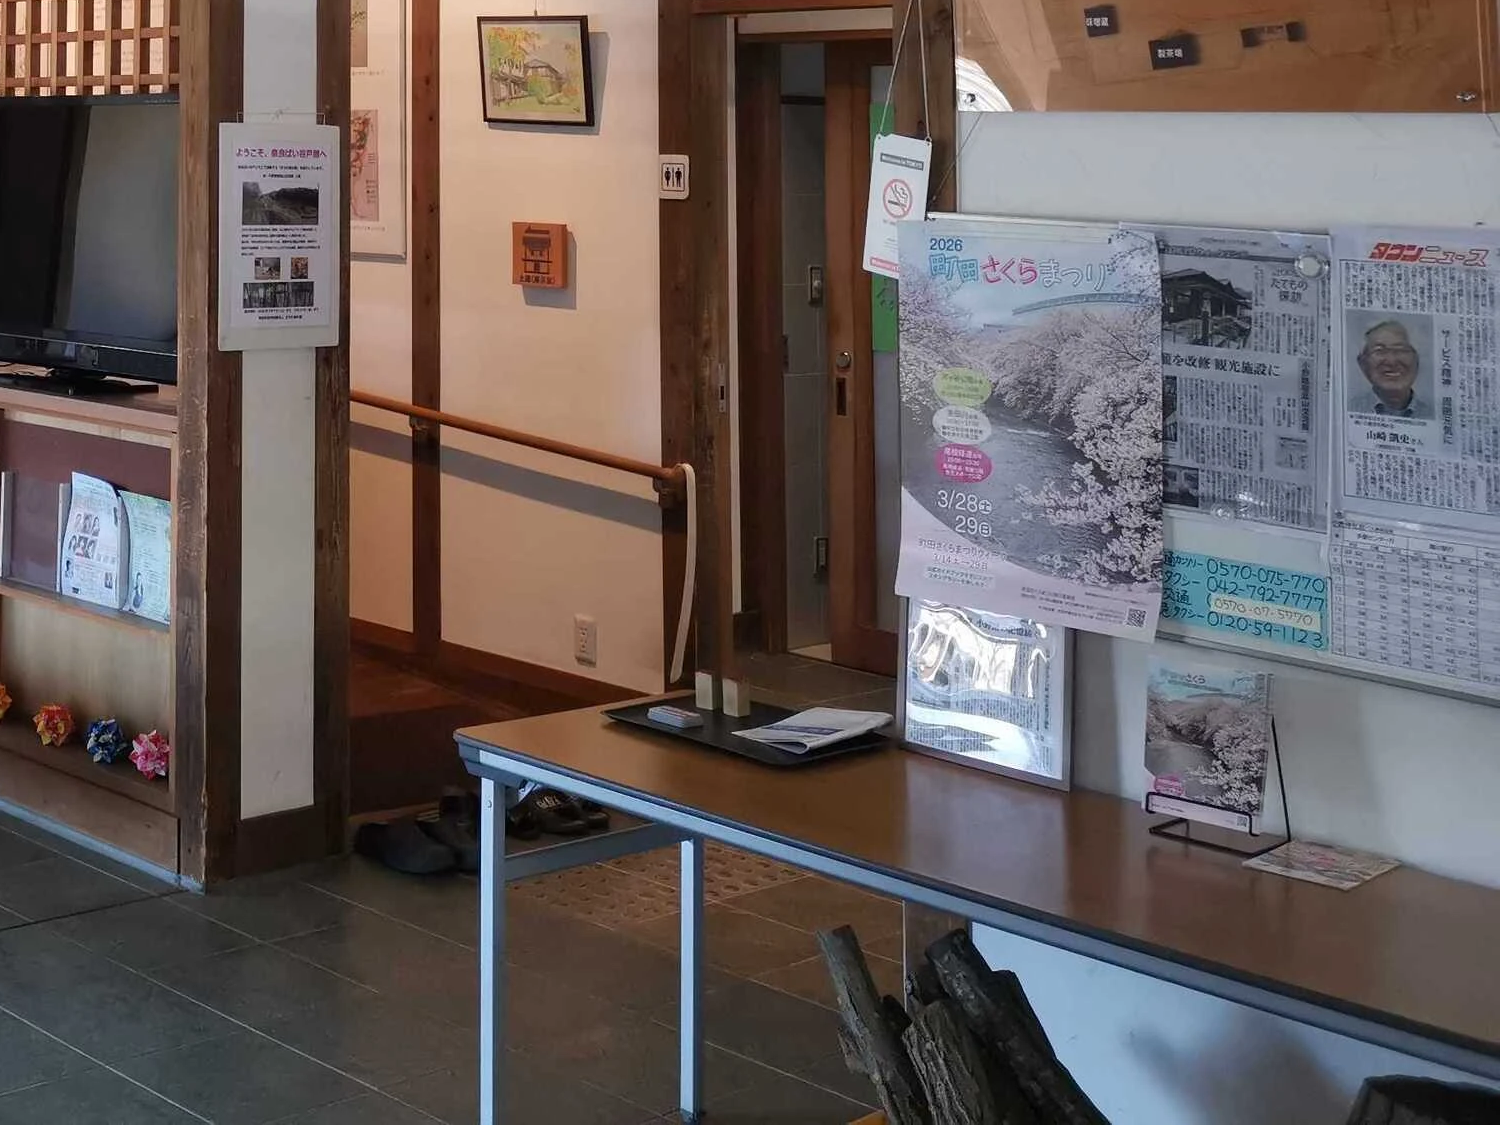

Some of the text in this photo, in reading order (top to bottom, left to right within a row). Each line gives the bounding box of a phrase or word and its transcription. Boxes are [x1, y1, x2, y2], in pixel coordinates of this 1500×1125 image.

[930, 238, 963, 252] 2026
[1369, 242, 1490, 268] タウンニュース
[929, 253, 1108, 292] 町田さくらまつり
[1270, 278, 1308, 291] たてもの
[1215, 357, 1281, 377] 観光施設に
[1206, 558, 1325, 594] 0570-075-770
[1206, 576, 1325, 611] 042-792-7777
